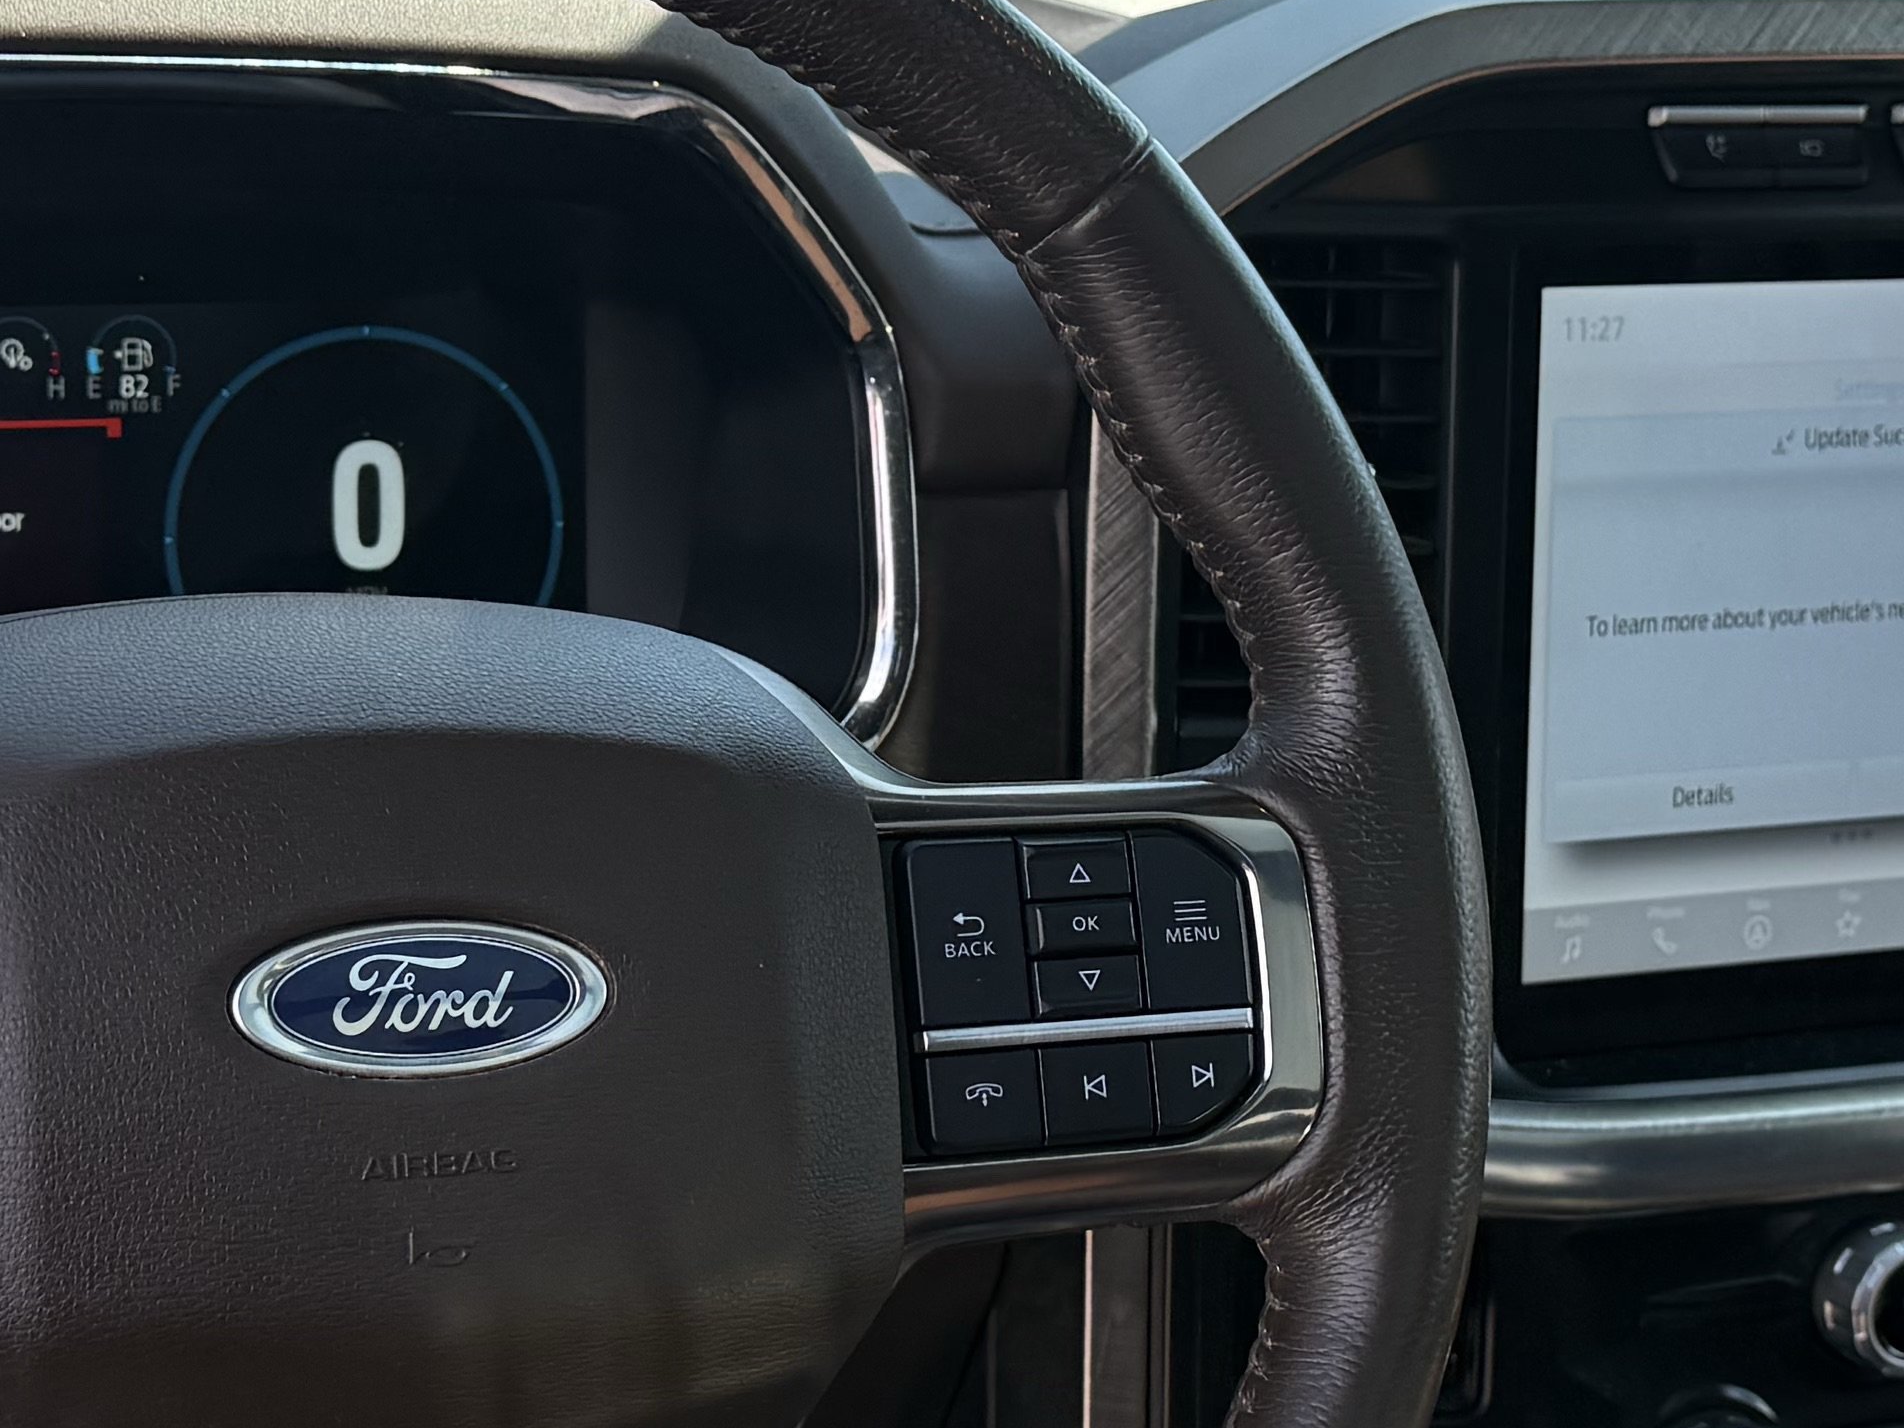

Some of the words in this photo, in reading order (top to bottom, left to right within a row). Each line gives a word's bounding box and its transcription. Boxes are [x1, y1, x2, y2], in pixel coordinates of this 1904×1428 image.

[1562, 313, 1625, 344] 11:27
[46, 377, 66, 400] H
[86, 377, 102, 400] E
[119, 374, 149, 399] 82
[166, 374, 182, 397] F
[1803, 423, 1870, 453] Update
[330, 437, 407, 572] 0
[1587, 615, 1608, 637] To
[1612, 614, 1657, 636] learn
[1662, 614, 1708, 632] more
[1712, 608, 1765, 630] about
[1768, 607, 1807, 631] your
[1811, 600, 1884, 623] vehicle's
[1671, 781, 1735, 809] Details
[1072, 915, 1099, 931] OK
[1165, 926, 1220, 944] MENU
[944, 941, 995, 958] BACK
[331, 953, 514, 1036] Ford
[361, 1148, 520, 1181] AIRBAG
